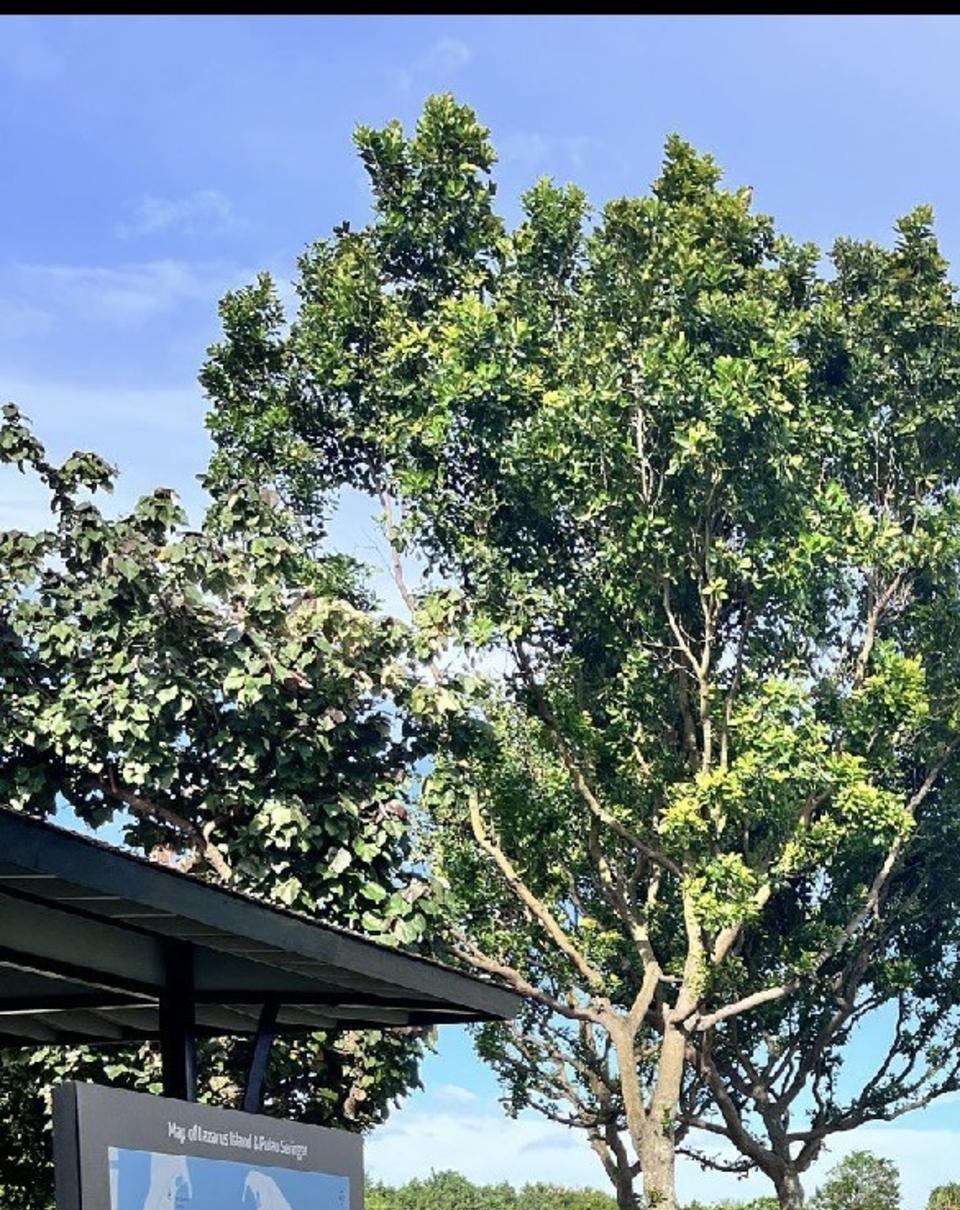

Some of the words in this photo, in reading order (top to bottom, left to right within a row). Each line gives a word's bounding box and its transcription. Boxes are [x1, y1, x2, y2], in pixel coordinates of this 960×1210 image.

[168, 1121, 185, 1144] Map
[188, 1124, 197, 1141] of
[198, 1126, 228, 1146] Lazarus
[229, 1131, 252, 1149] Island
